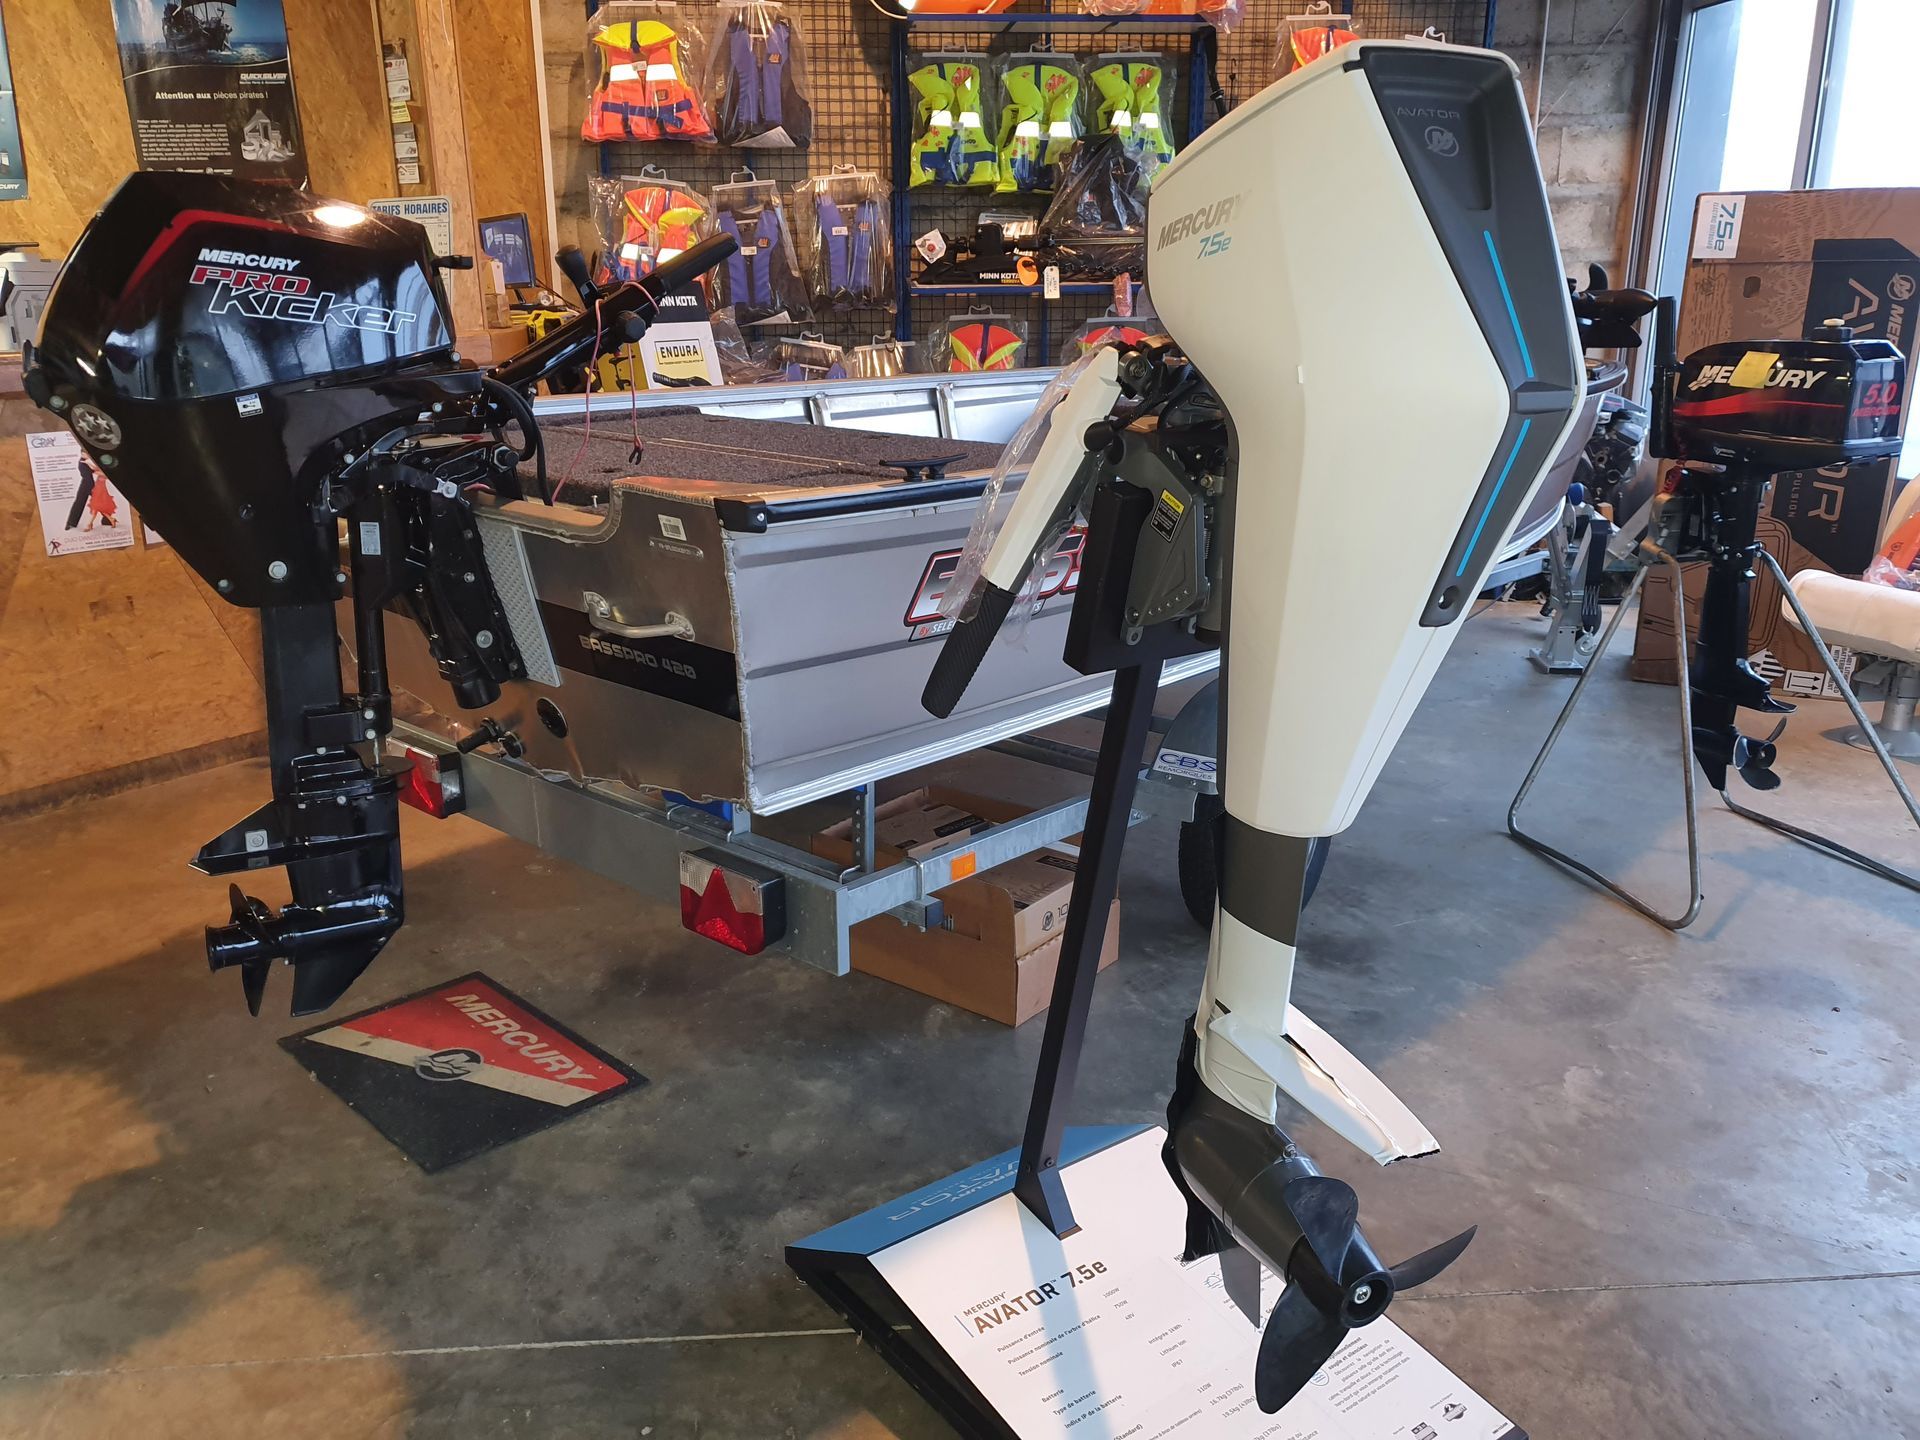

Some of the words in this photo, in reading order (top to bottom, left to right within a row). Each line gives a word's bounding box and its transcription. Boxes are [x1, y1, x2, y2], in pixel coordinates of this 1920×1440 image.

[155, 91, 195, 100] Attention
[196, 92, 212, 100] aux
[213, 91, 238, 101] pièces
[239, 91, 264, 101] pirates
[1397, 107, 1460, 119] AVATOR
[404, 202, 448, 215] HORAIRES
[1710, 202, 1719, 223] ELECTRIC
[1706, 224, 1716, 250] OUTBOARD
[1714, 202, 1737, 251] 7.5e
[1197, 231, 1232, 259] 7.5e
[198, 248, 300, 271] MERCURY
[189, 264, 311, 296] PRO
[676, 295, 698, 307] KOTA
[660, 344, 699, 359] ENDURA
[1697, 364, 1828, 389] MEURY
[1863, 382, 1898, 405] 5.0
[1787, 472, 1803, 518] PULSION
[918, 625, 930, 639] By
[578, 634, 658, 668] BASSPRO
[661, 658, 697, 680] 420
[1160, 753, 1217, 772] CBS
[445, 994, 598, 1080] MERCURY
[1060, 1261, 1108, 1289] 7.5e
[963, 1291, 1006, 1317] MERCURY
[1114, 1299, 1128, 1309] 750W
[997, 1338, 1023, 1353] Puissance
[1023, 1326, 1045, 1340] d'entrée
[1007, 1349, 1034, 1365] Puissance
[1034, 1336, 1058, 1352] nominale
[1064, 1324, 1082, 1336] l'arbre
[1081, 1315, 1101, 1327] d'hélice
[1018, 1363, 1040, 1377] Tension
[1040, 1351, 1064, 1366] nominale
[1041, 1388, 1064, 1403] Batterie
[1196, 1382, 1212, 1394] 110W
[1053, 1406, 1067, 1416] Type
[1073, 1389, 1096, 1404] batterie
[1064, 1418, 1081, 1429] Indice
[1100, 1394, 1122, 1409] batterie
